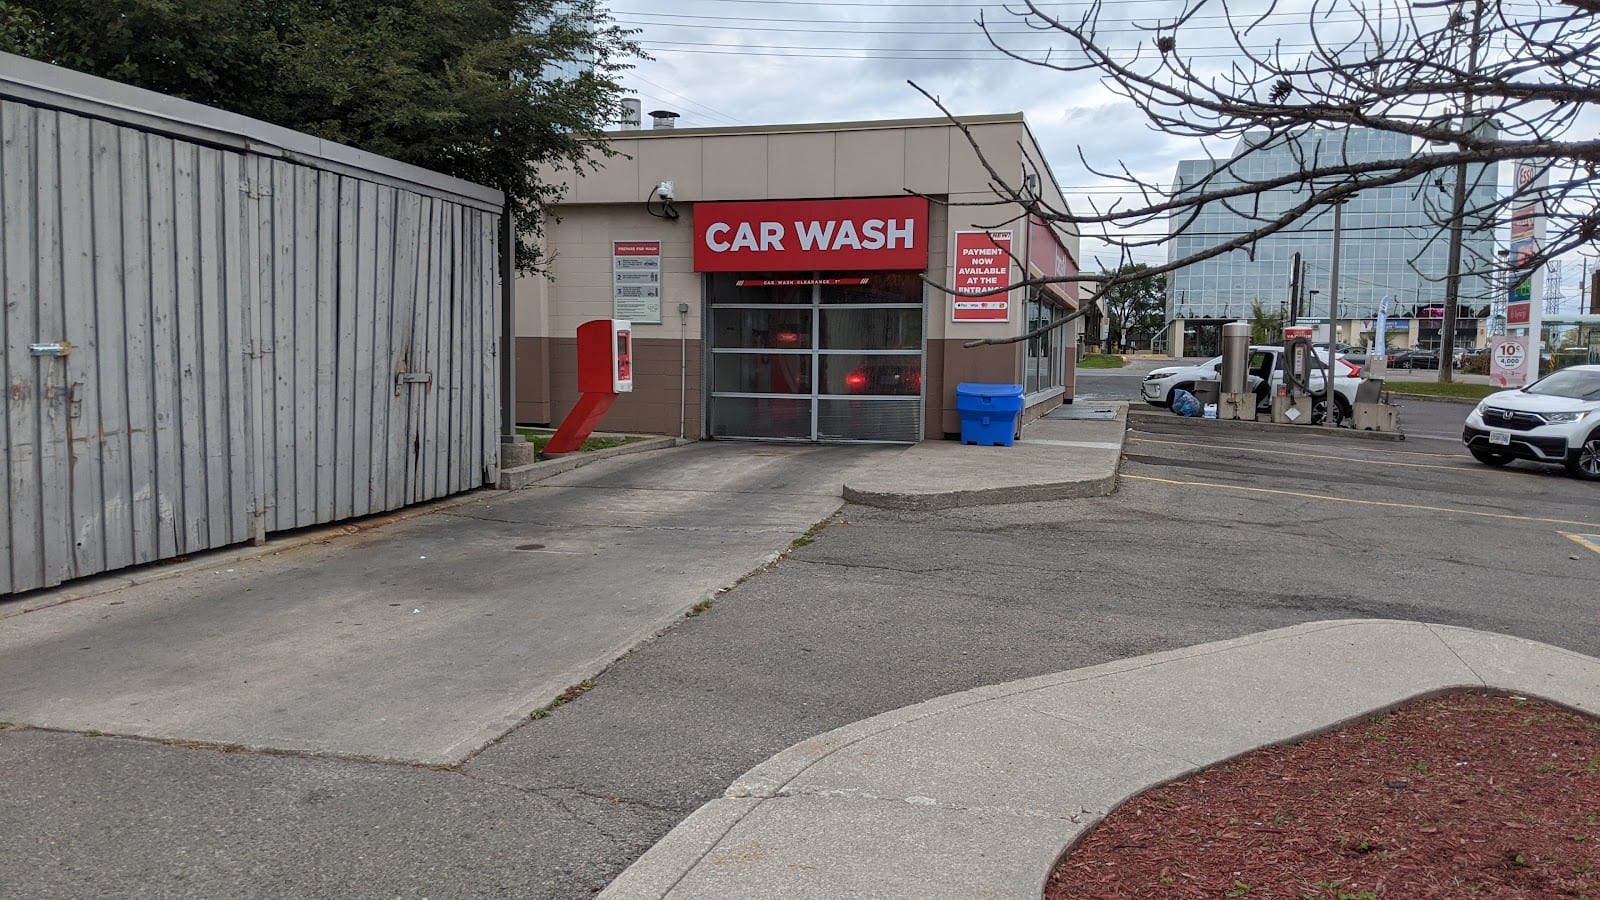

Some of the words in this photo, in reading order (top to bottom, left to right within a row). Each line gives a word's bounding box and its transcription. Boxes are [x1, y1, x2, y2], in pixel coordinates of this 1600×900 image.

[705, 222, 785, 252] CAR
[795, 218, 914, 251] WASH
[958, 267, 1007, 275] AVAILABLE
